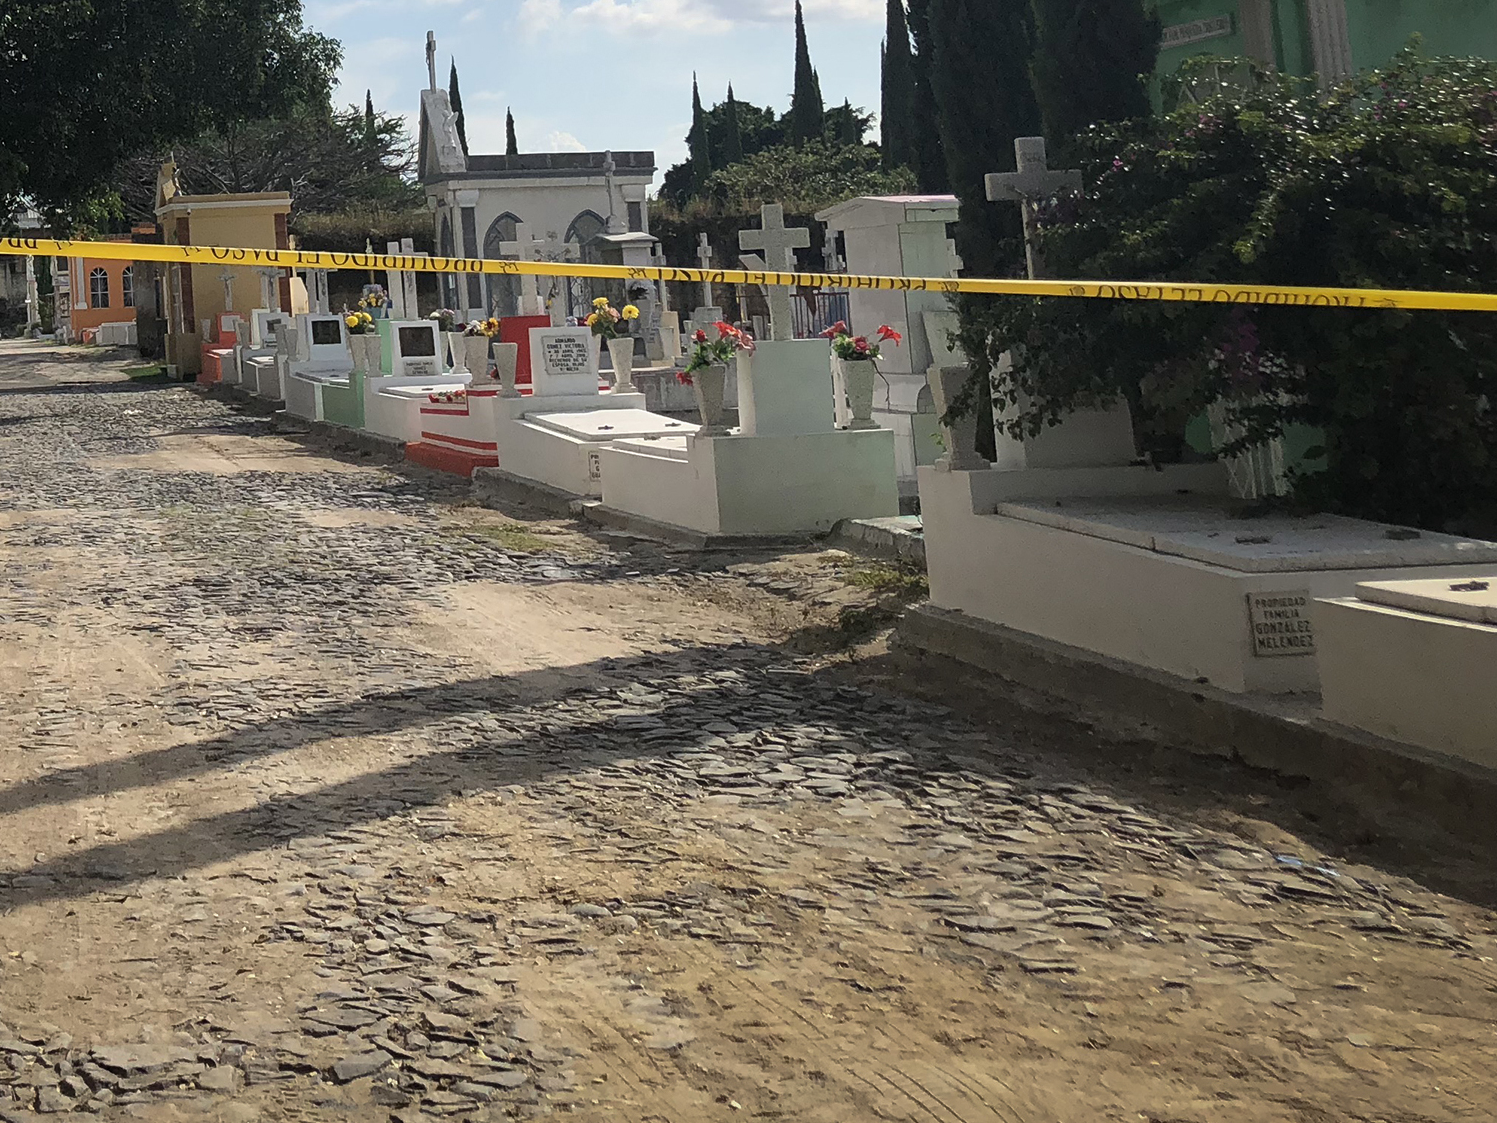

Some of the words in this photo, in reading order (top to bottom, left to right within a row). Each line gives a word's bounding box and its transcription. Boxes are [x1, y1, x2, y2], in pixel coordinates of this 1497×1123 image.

[1255, 596, 1306, 609] PROPIEDAD
[1263, 608, 1300, 620] FAMILIA
[1255, 620, 1311, 634] GONZALEZ
[1257, 634, 1315, 649] MELENDEZ
